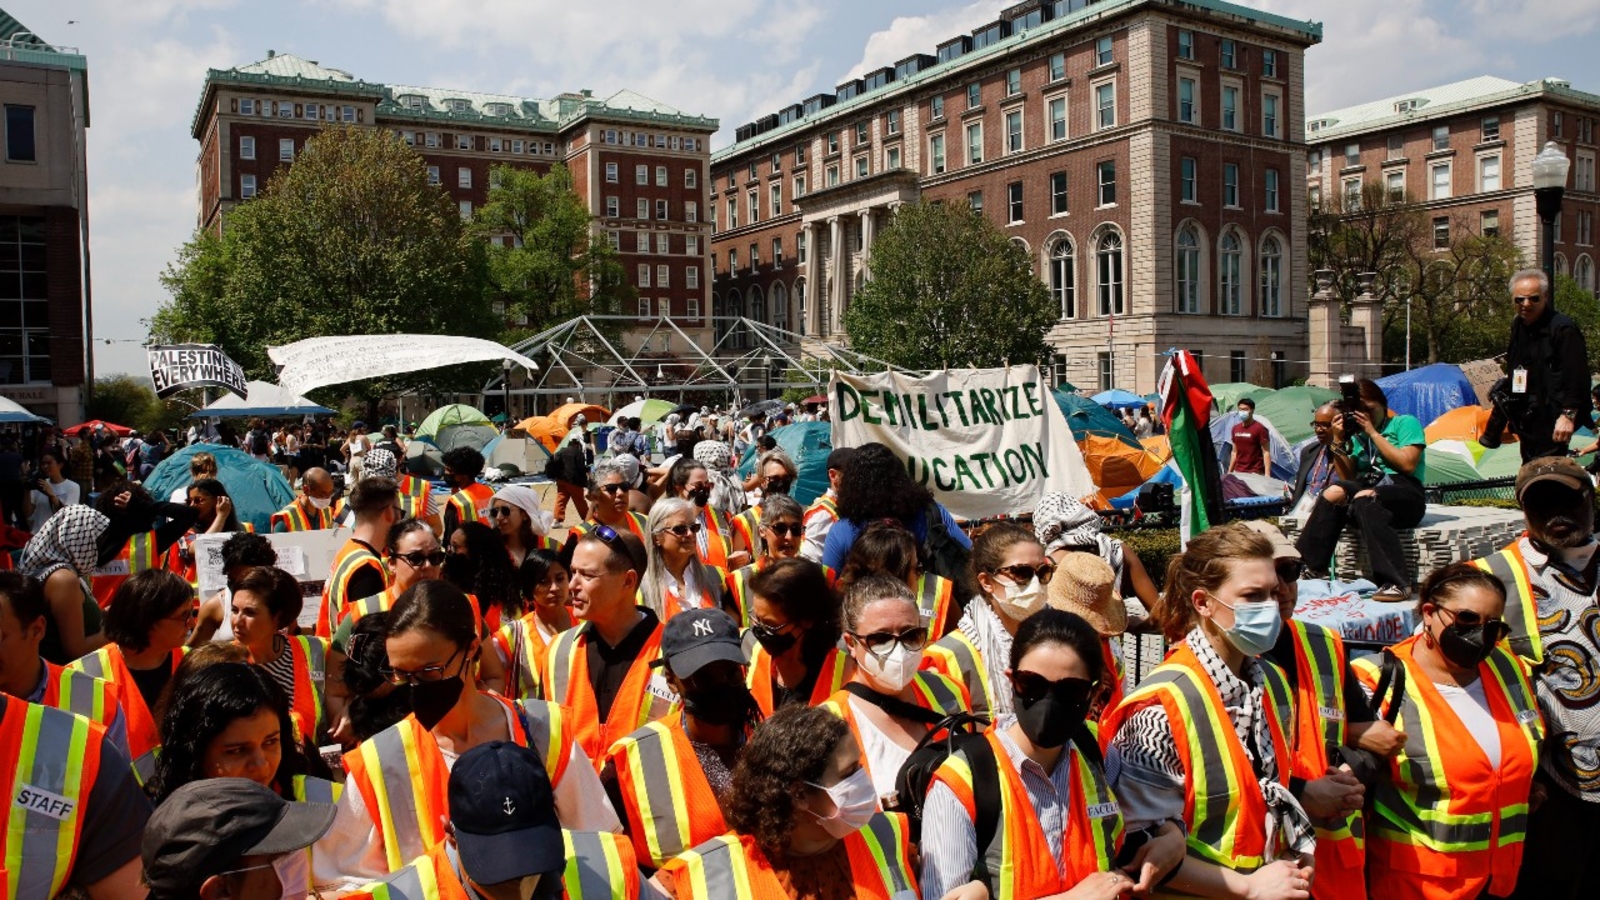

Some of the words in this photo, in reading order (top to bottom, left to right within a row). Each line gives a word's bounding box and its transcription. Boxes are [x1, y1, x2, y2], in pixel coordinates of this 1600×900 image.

[150, 350, 230, 370] PALESTINE
[152, 365, 248, 392] EVERYWHERE
[19, 391, 44, 399] HALL
[836, 382, 1043, 431] DEMILITARIZE
[908, 442, 1050, 491] UCATION
[17, 790, 73, 817] STAFF
